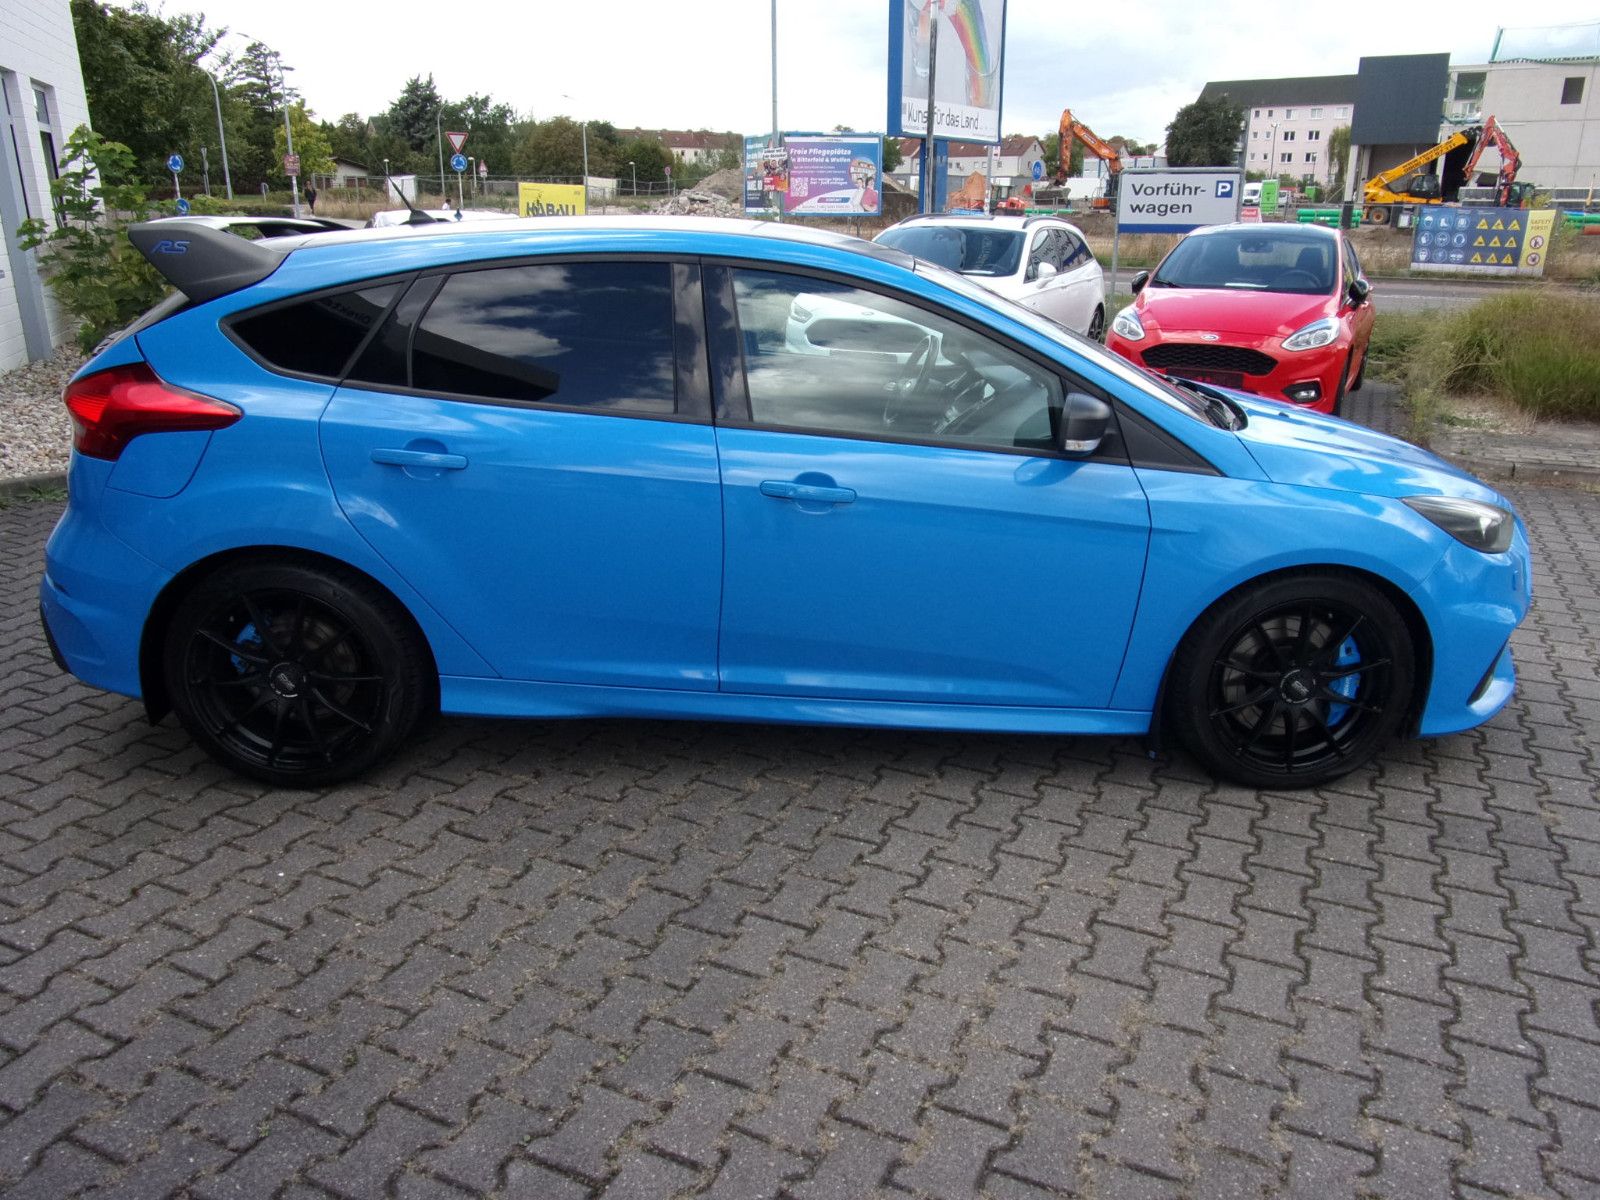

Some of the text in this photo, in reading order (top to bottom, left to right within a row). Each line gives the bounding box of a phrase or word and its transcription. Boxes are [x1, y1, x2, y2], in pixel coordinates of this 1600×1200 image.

[907, 102, 931, 124] Kuns
[946, 107, 960, 128] das
[960, 111, 979, 130] Land
[1131, 182, 1231, 197] Vorführ- P
[1129, 203, 1193, 217] wagen
[152, 240, 190, 255] RS
